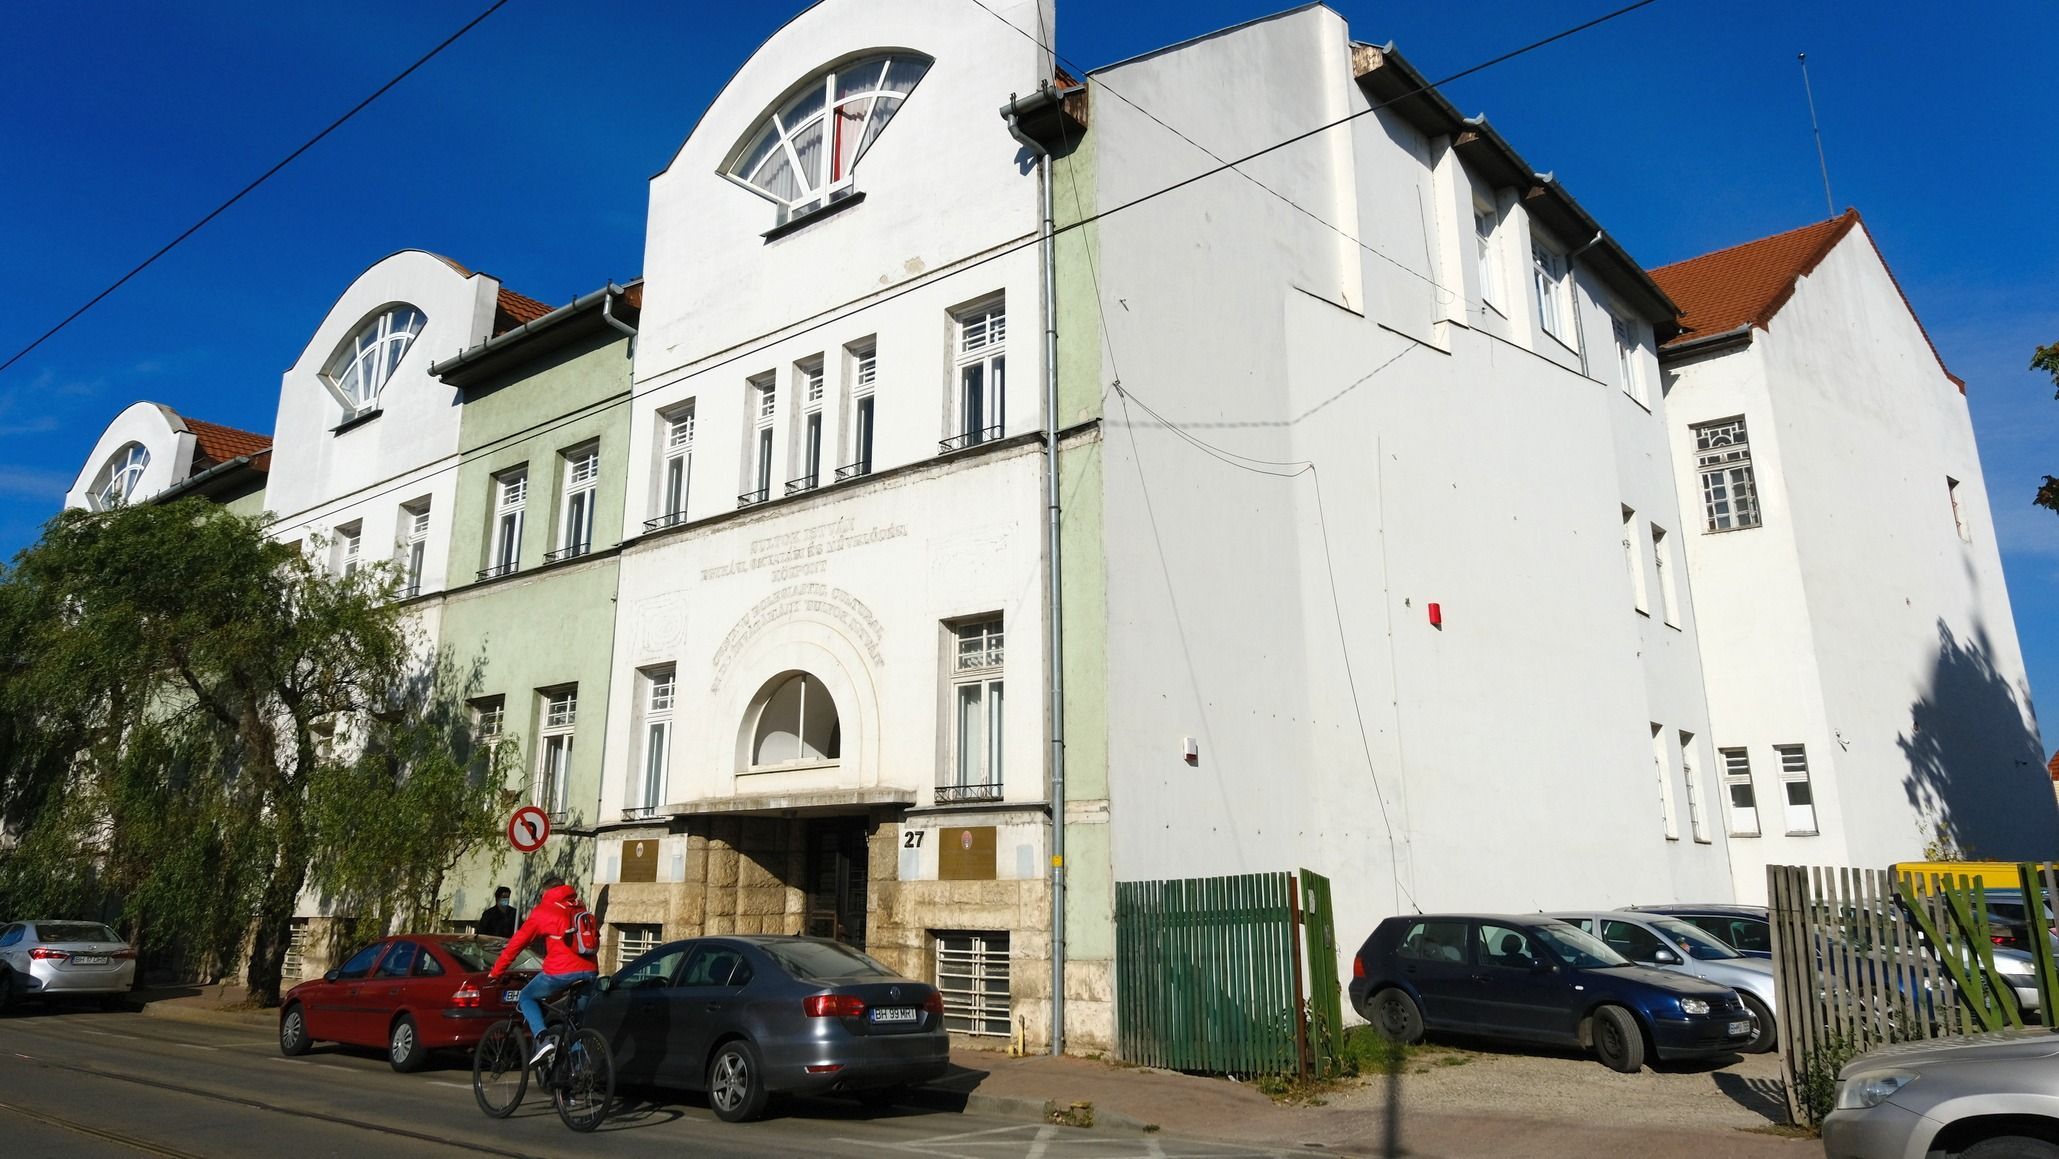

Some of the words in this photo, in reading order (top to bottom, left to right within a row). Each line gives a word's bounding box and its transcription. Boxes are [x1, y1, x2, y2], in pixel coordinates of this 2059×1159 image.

[904, 831, 925, 849] 27
[876, 1008, 888, 1020] BH
[889, 1008, 900, 1019] 99
